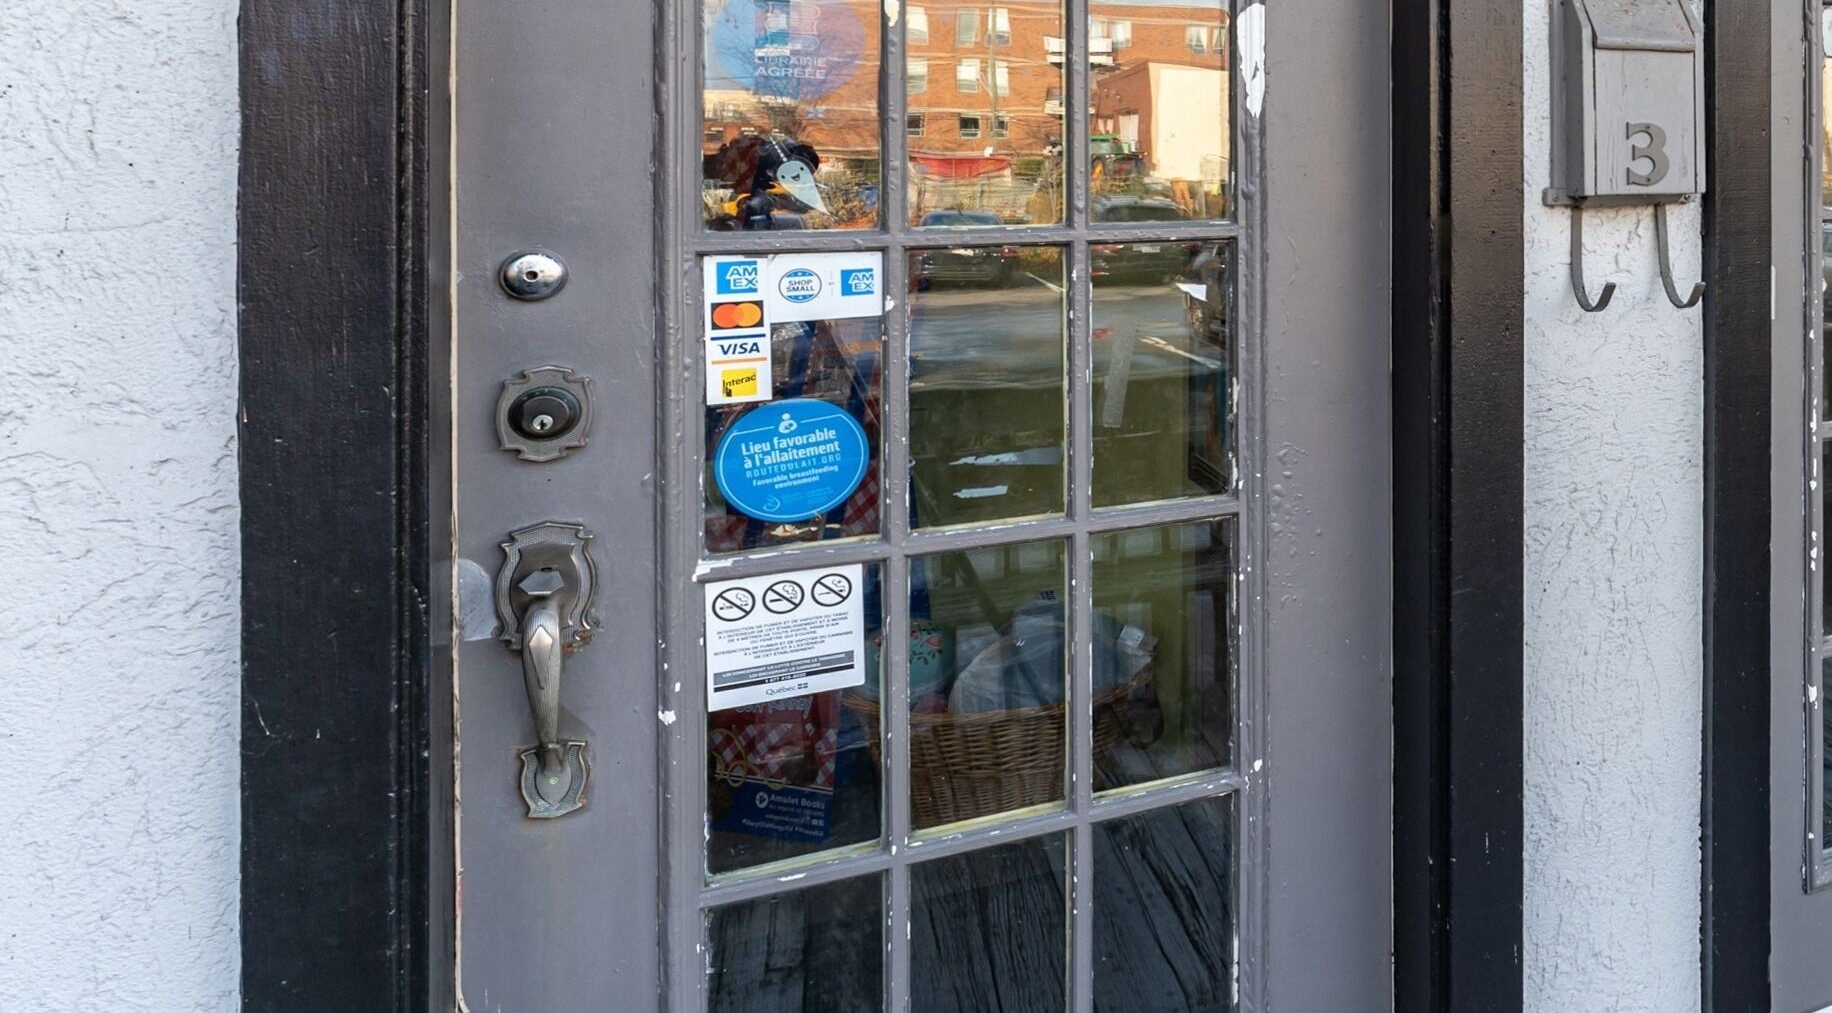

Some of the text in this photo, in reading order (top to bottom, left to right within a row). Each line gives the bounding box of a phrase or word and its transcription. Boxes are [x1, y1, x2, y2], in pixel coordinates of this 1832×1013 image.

[1626, 121, 1670, 186] 3
[727, 265, 758, 278] AM
[851, 273, 873, 282] AM
[786, 285, 815, 293] SMALL
[719, 342, 760, 355] VISA
[722, 374, 757, 393] Interac
[741, 428, 837, 455] Lieu favorable
[744, 441, 840, 469] à l'allaitement
[746, 453, 841, 479] ROUTEDULAIT.ORG
[789, 465, 838, 479] breastfeeding
[775, 475, 820, 489] environment
[765, 684, 796, 696] Québec
[770, 793, 799, 806] Amulet
